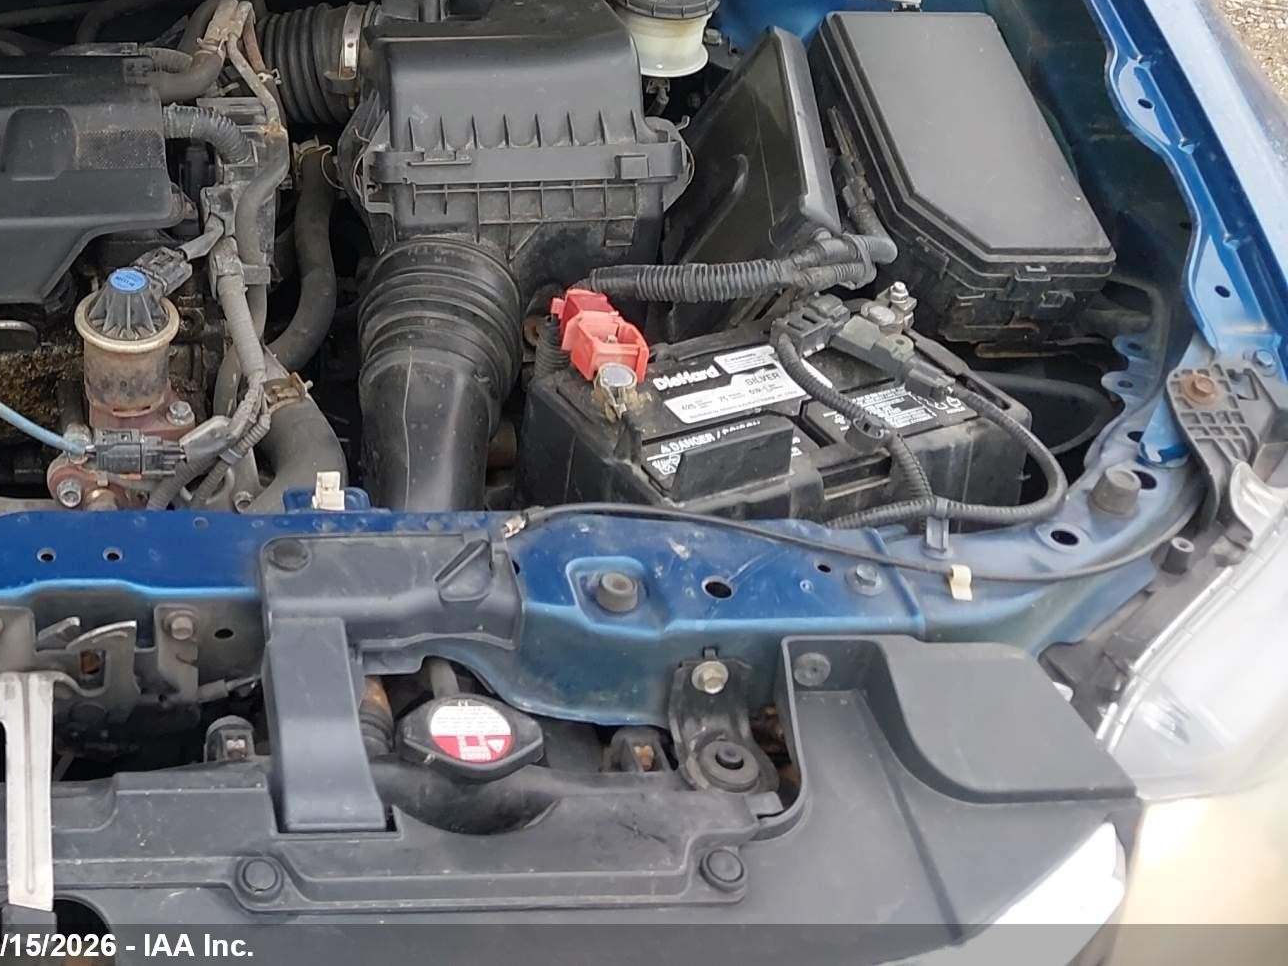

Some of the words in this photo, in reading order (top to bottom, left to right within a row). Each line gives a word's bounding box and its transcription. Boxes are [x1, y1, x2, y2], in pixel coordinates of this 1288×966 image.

[652, 365, 721, 391] DieHard
[744, 371, 781, 386] SILVER
[669, 432, 716, 452] DANGER
